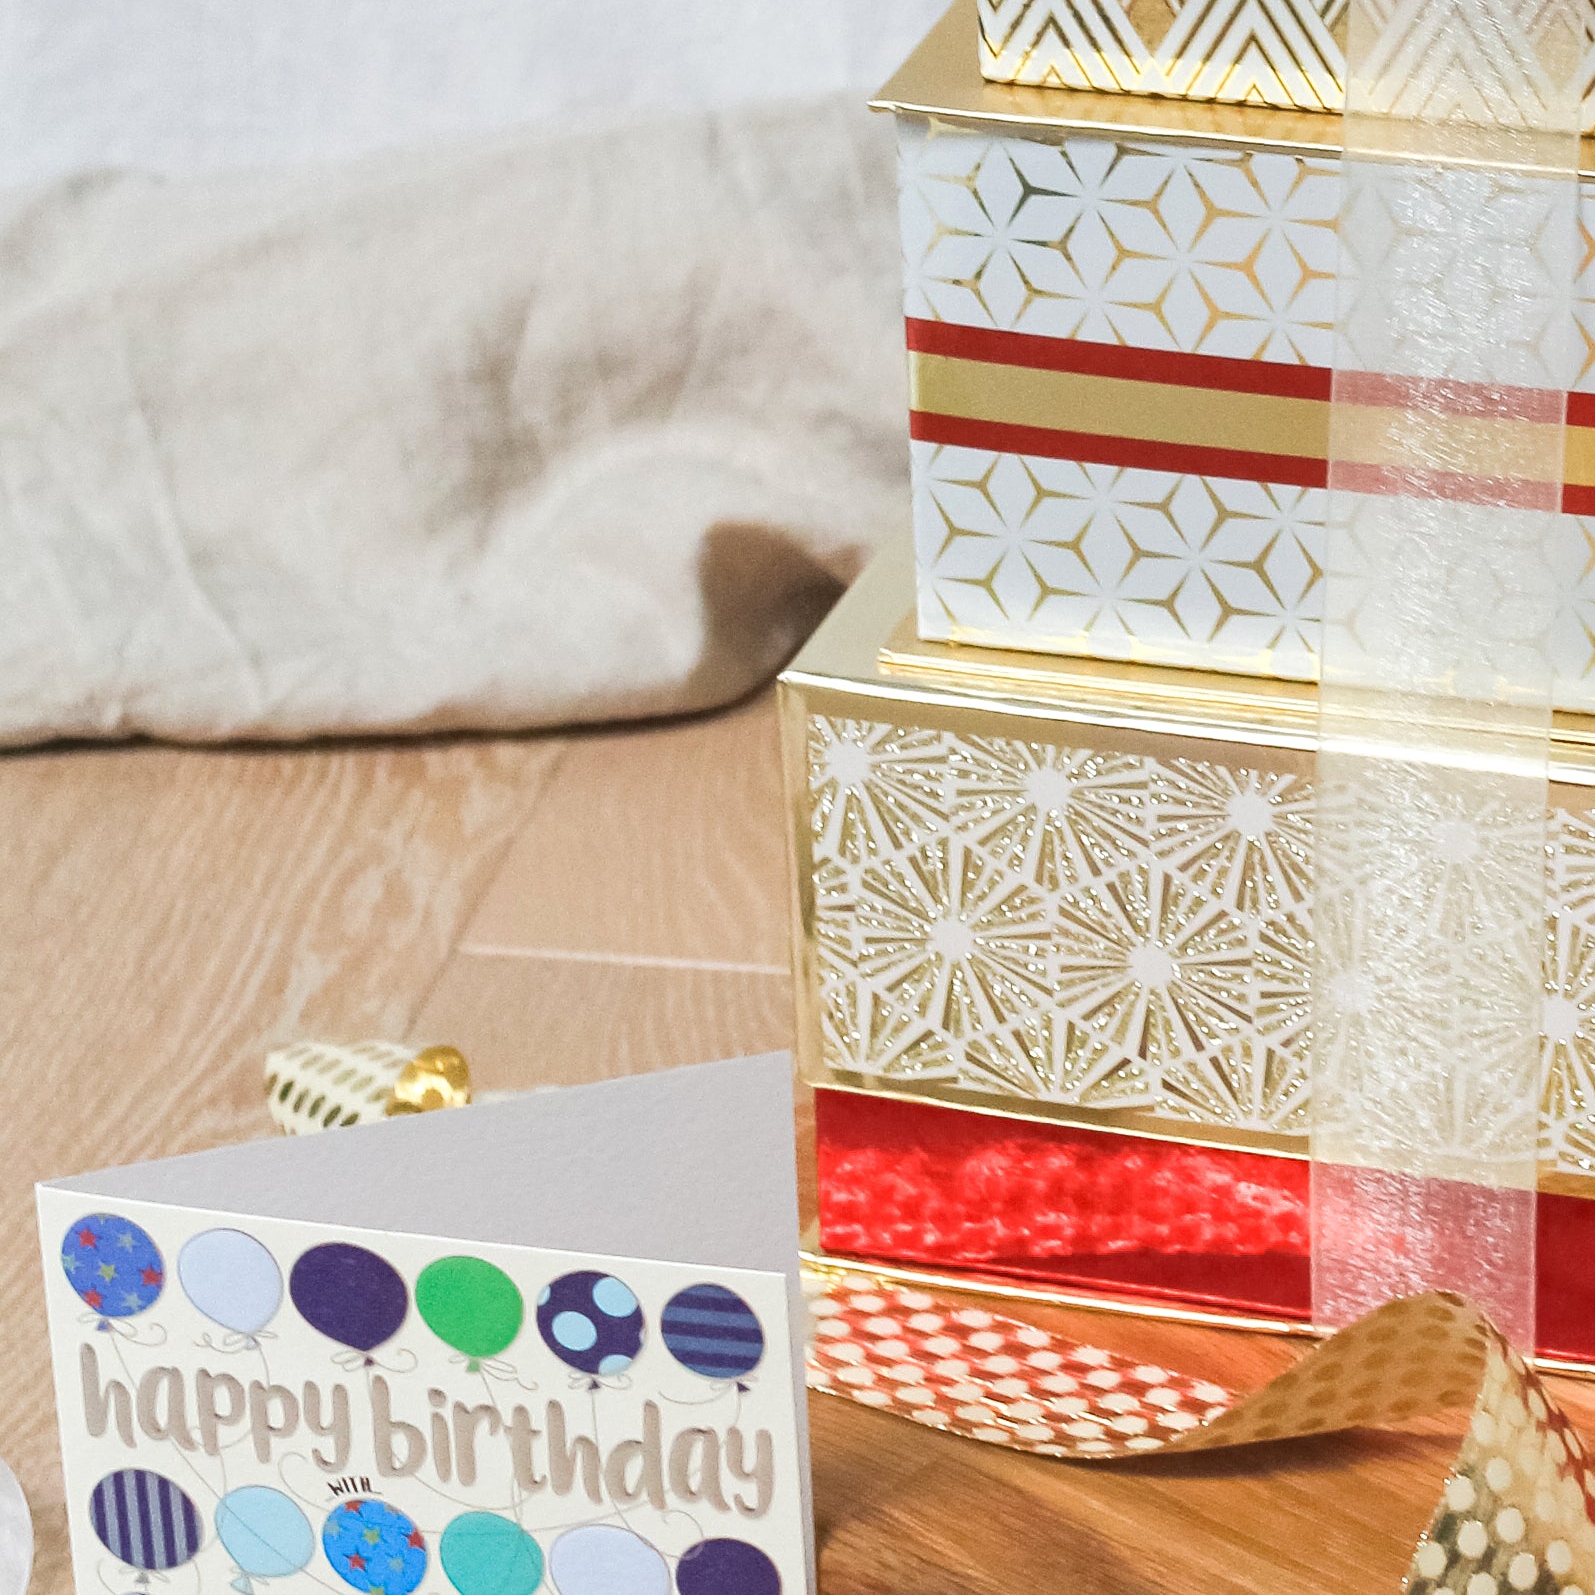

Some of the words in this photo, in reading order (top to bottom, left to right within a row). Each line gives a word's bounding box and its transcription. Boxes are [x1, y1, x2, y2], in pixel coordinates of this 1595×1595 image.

[79, 1341, 351, 1473] happy
[371, 1374, 777, 1516] birthday
[326, 1476, 382, 1497] WITH
